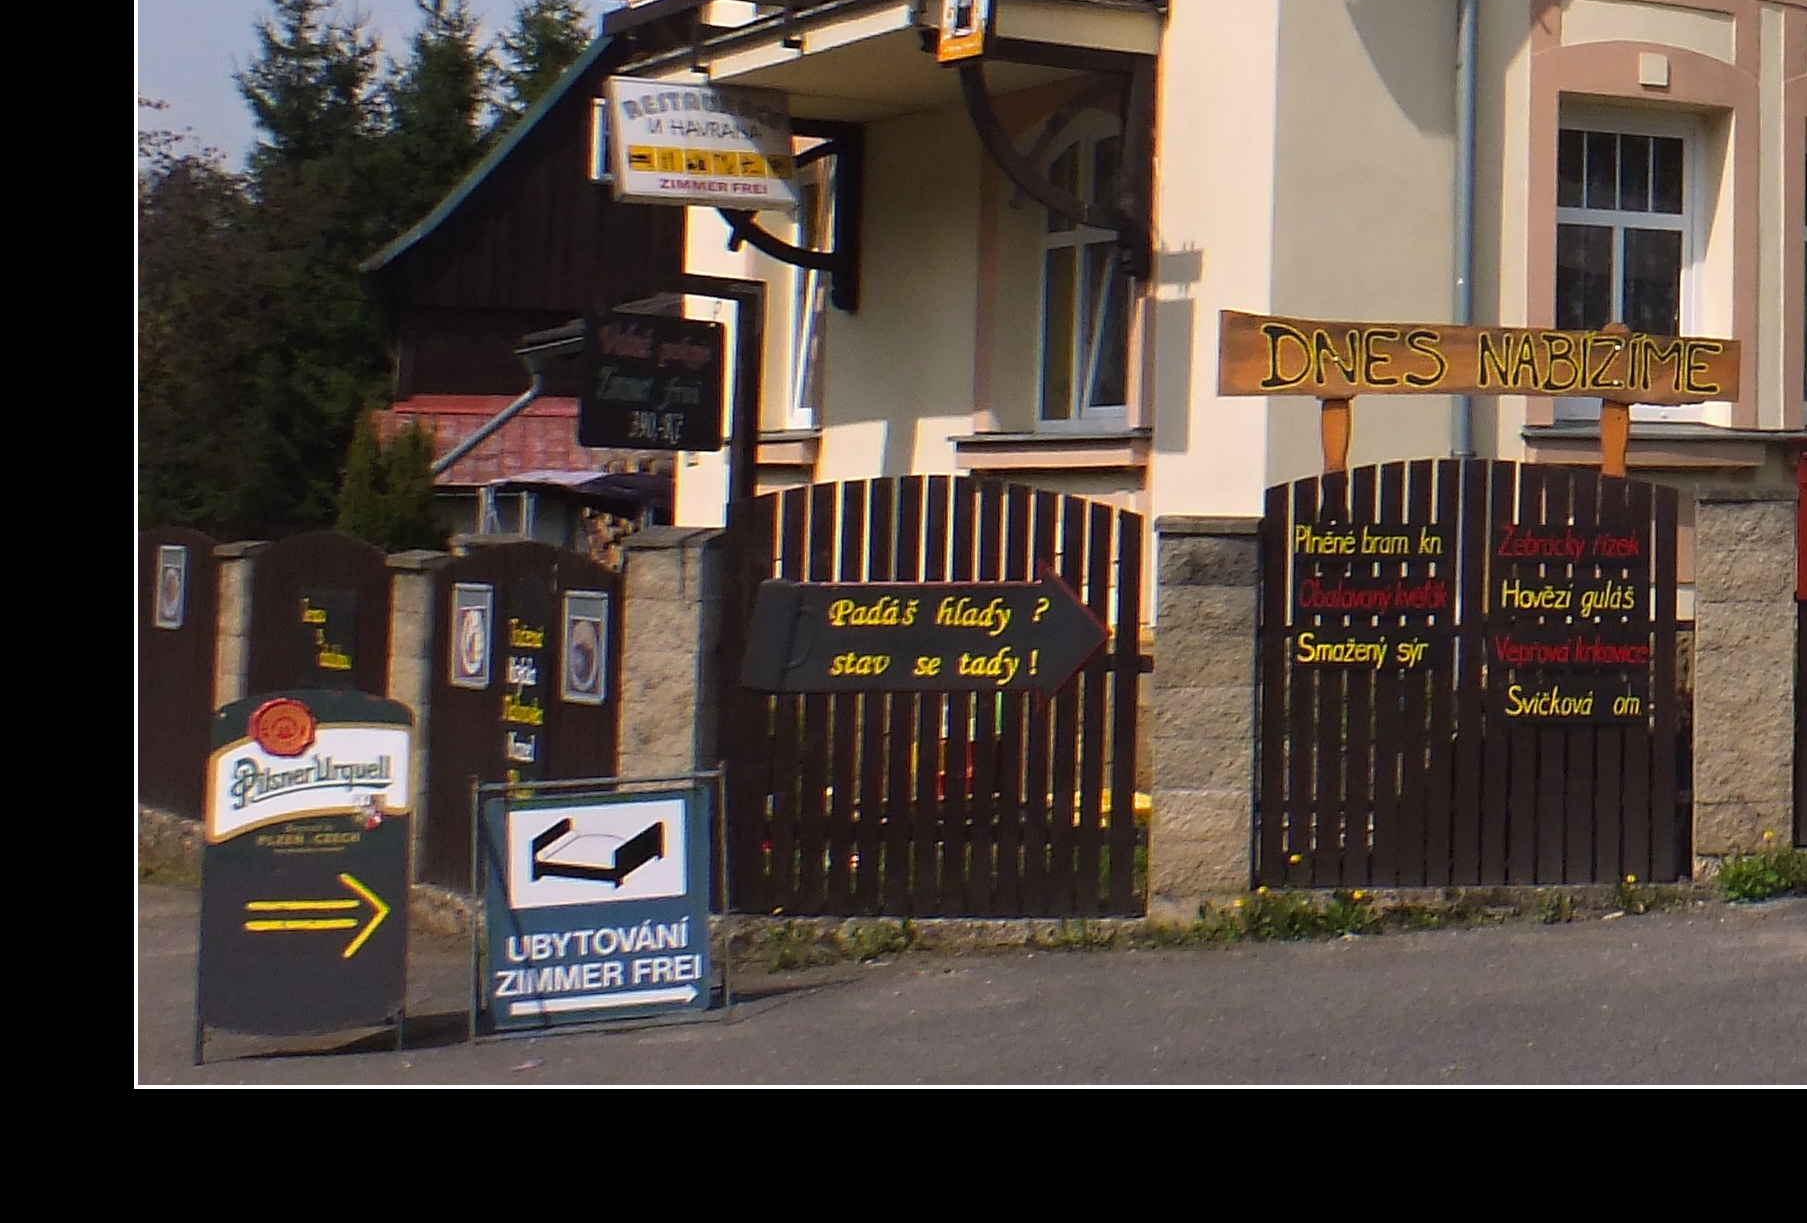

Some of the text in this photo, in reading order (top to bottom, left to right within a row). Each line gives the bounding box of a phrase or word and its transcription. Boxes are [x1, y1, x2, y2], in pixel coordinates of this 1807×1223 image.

[660, 178, 768, 194] ZIMMER FREI
[1260, 322, 1449, 390] DNES
[1361, 525, 1410, 554] bram
[1418, 525, 1443, 554] kn
[828, 595, 1050, 637] Padáš hlady ?
[829, 651, 892, 676] stav
[914, 654, 943, 676] se
[1297, 632, 1429, 670] Smažený sýr
[230, 753, 393, 810] Pilsner Urquell
[507, 915, 690, 963] UBYTOVÁNÍ
[494, 953, 704, 998] ZIMMER FREI
